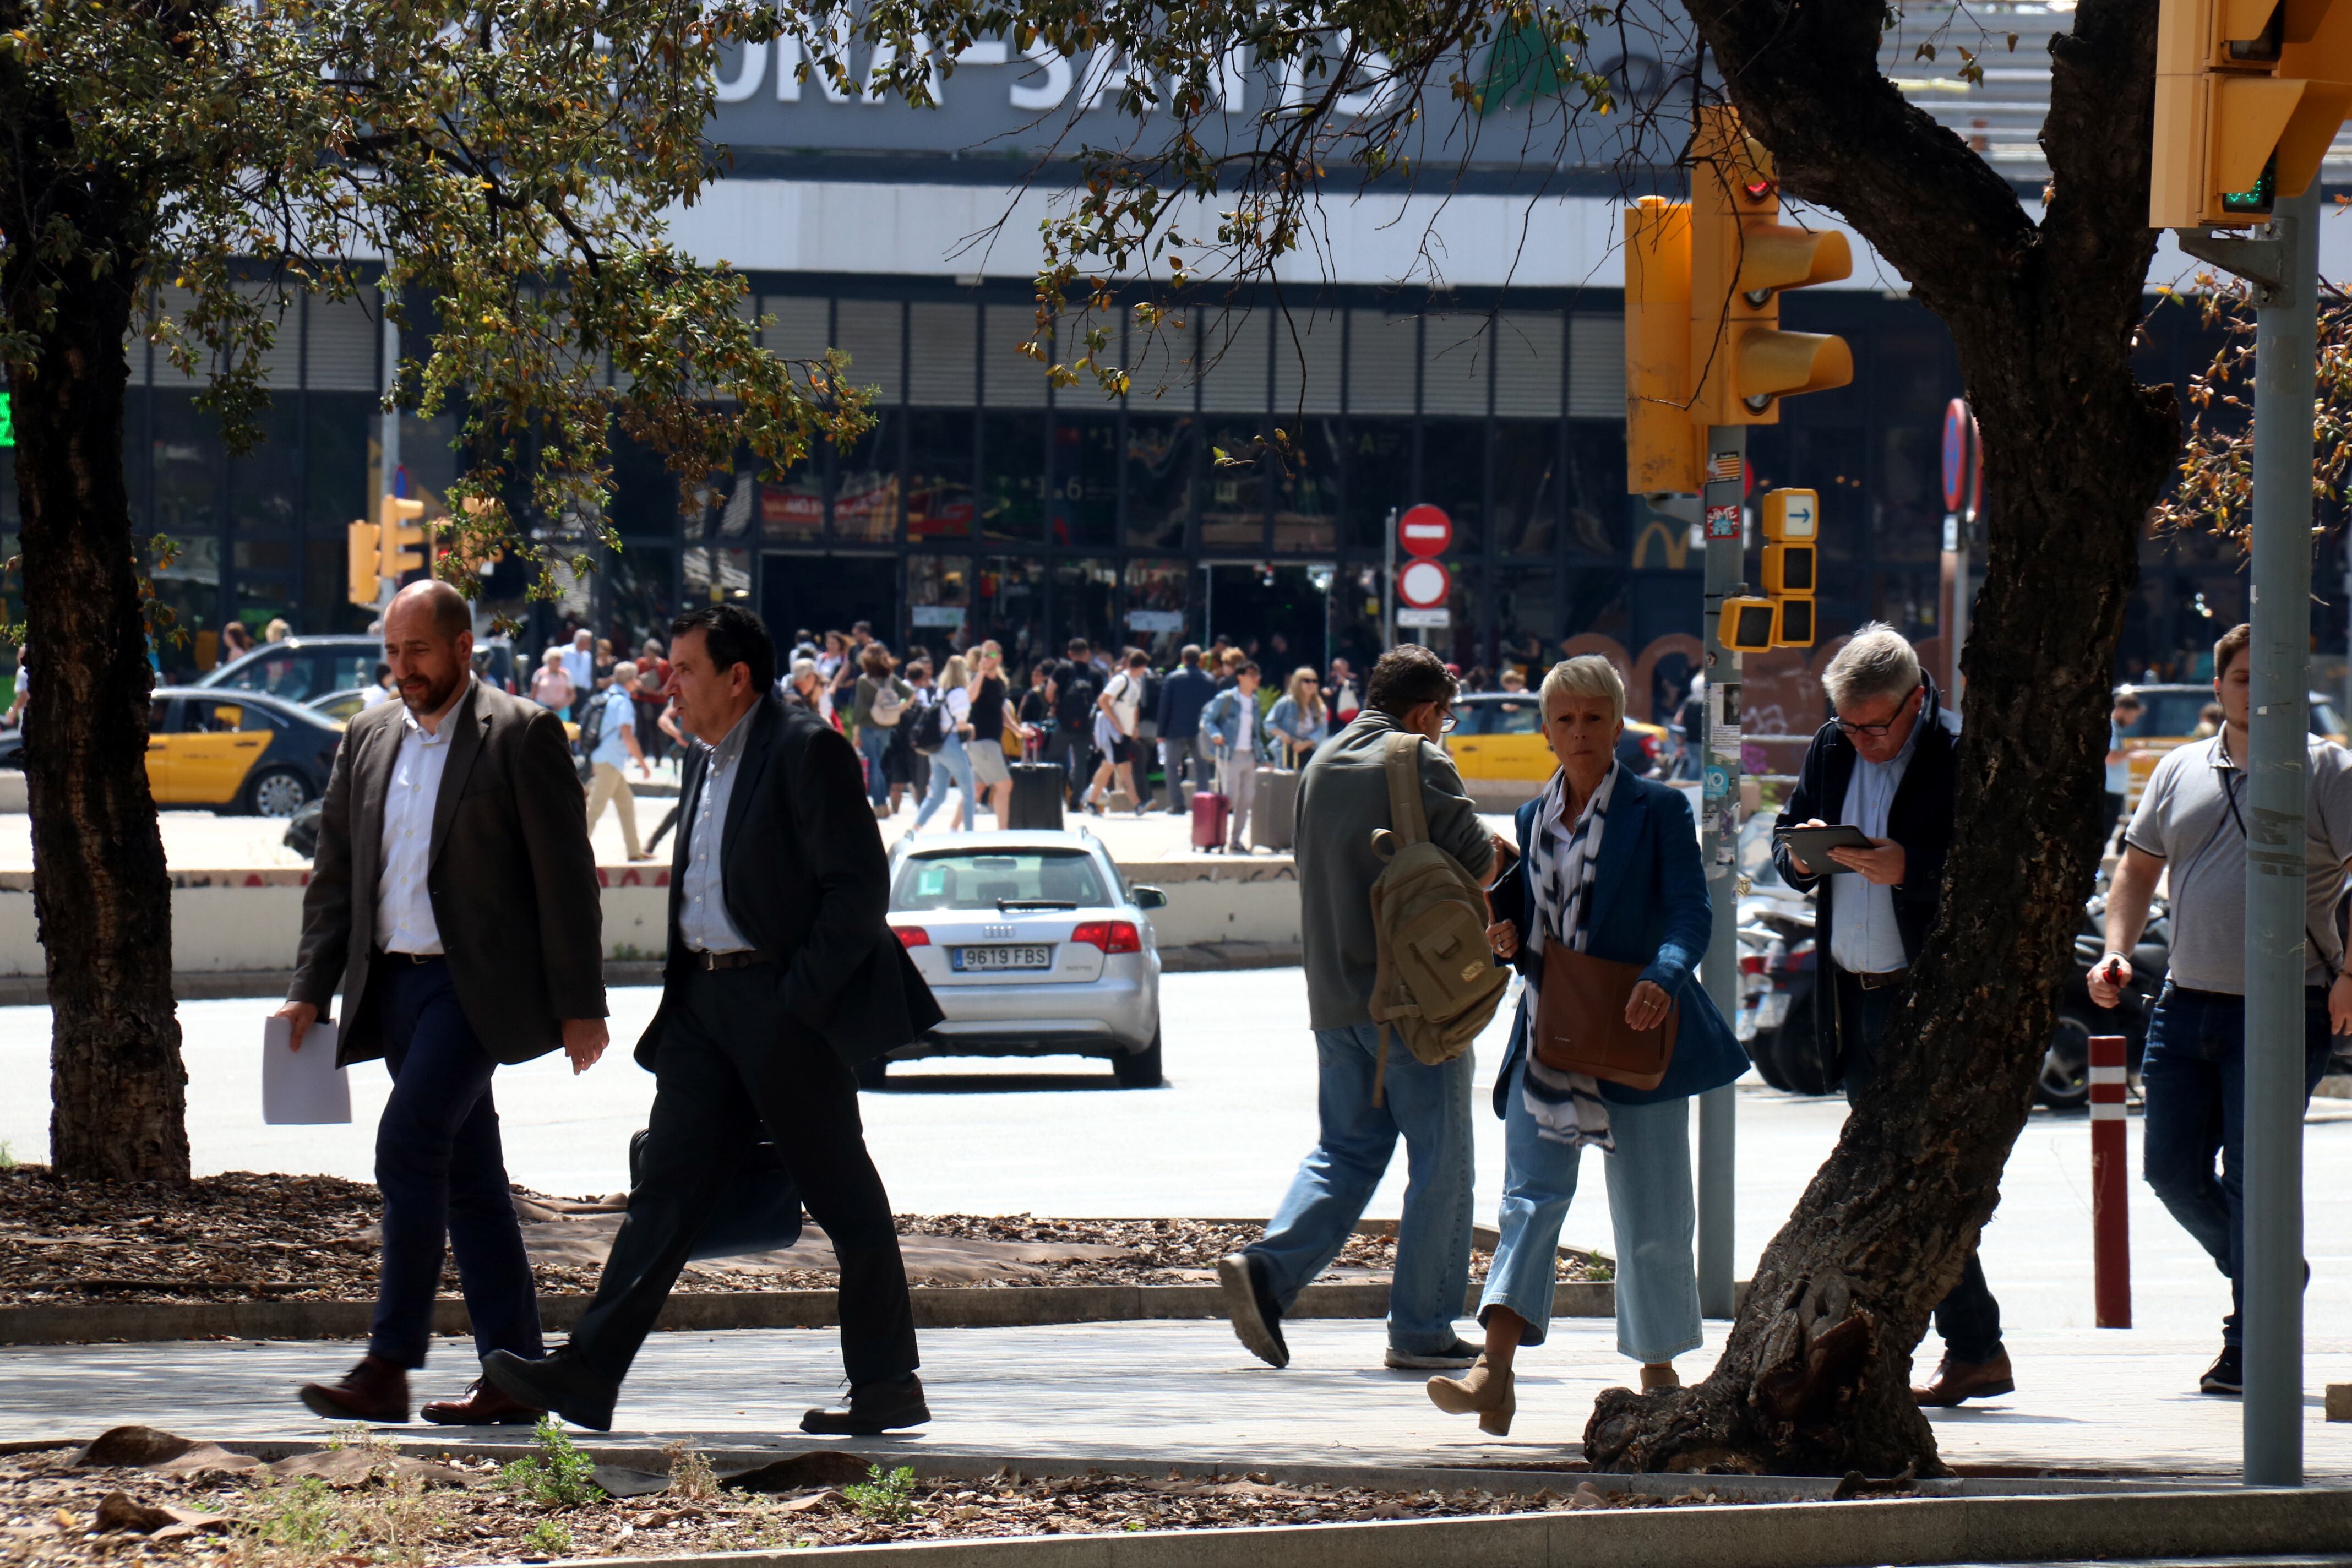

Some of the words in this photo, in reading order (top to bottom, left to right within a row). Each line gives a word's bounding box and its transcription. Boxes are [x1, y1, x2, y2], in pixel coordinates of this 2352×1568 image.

[921, 873, 940, 895] L
[966, 950, 1008, 965] 9619
[1014, 949, 1046, 963] FBS
